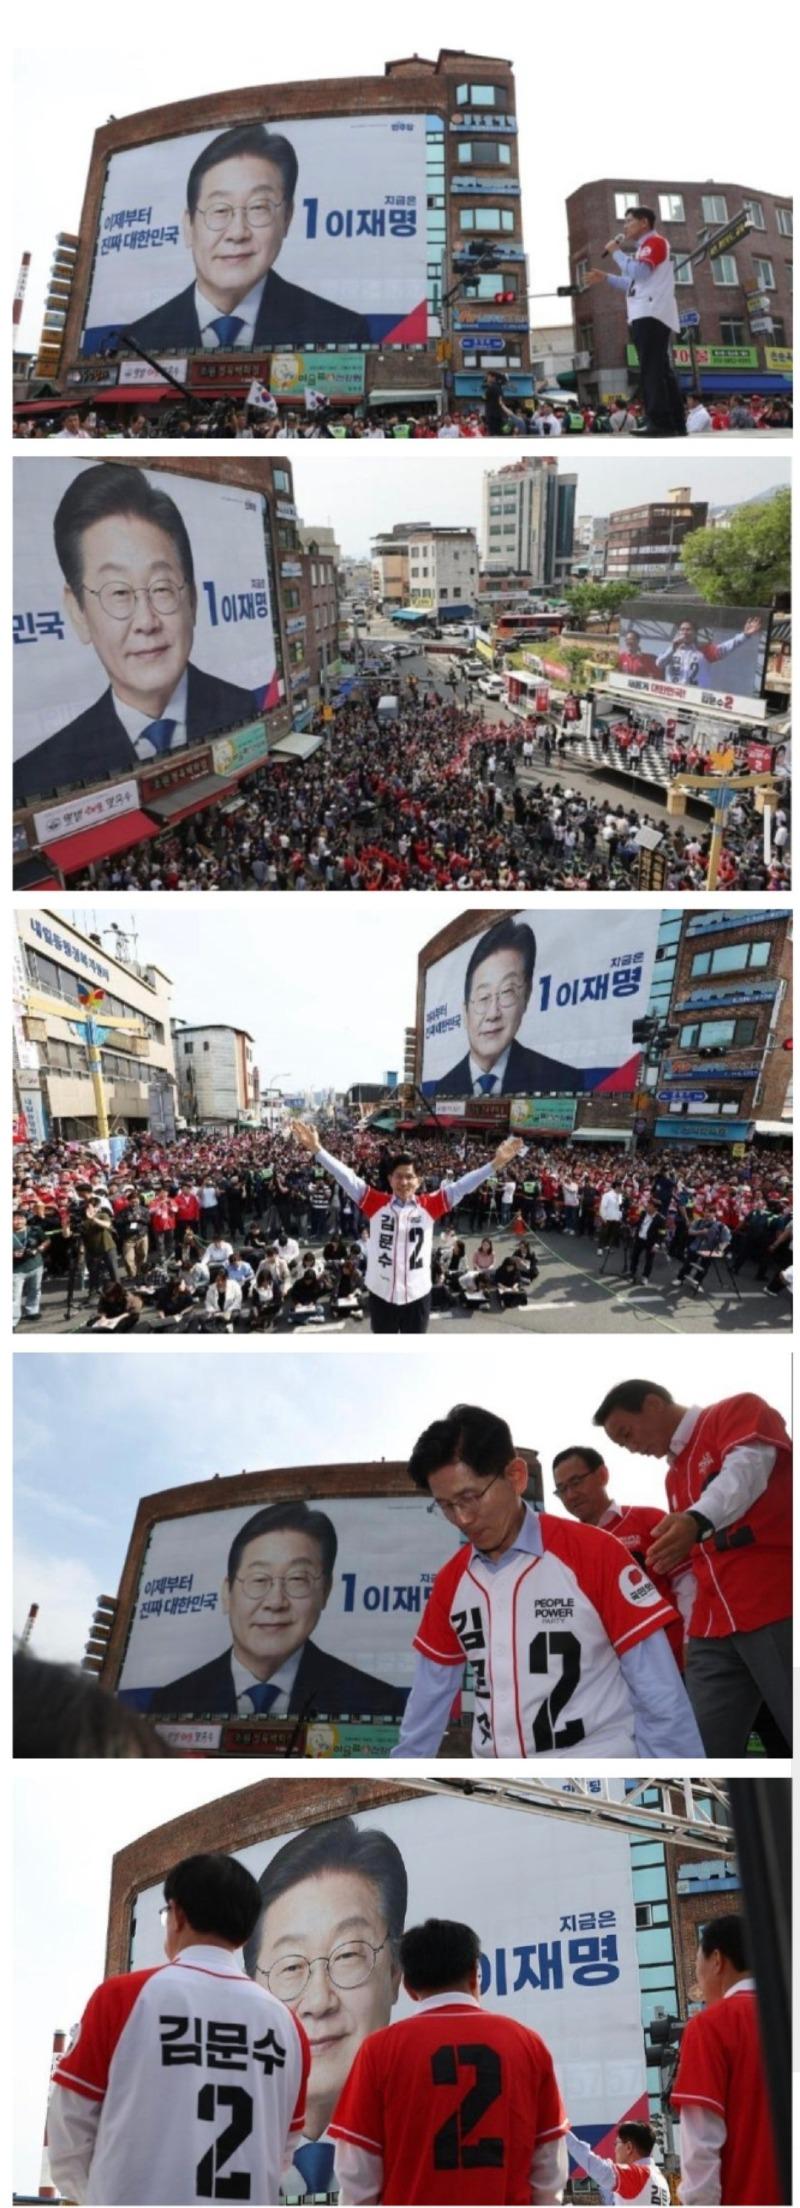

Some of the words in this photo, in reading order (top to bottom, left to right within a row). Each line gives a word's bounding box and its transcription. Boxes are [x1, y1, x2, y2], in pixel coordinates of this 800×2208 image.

[384, 195, 416, 206] 지금은
[104, 206, 152, 232] 이제부터
[303, 198, 318, 239] 1
[326, 209, 417, 237] 이재명
[101, 233, 121, 255] 진짜
[123, 225, 179, 250] 대한민국
[203, 581, 218, 626] 1
[222, 592, 268, 622] 이재명
[13, 611, 64, 644] 민국
[724, 696, 735, 710] 2
[610, 952, 644, 968] 지금은
[539, 974, 551, 1012] 1
[556, 966, 642, 1007] 이재명
[378, 1214, 396, 1268] 김문수
[409, 1227, 424, 1270] 2
[144, 1573, 194, 1597] 이제부터
[342, 1573, 356, 1613] 1
[140, 1600, 163, 1619] 진짜
[164, 1592, 218, 1615] 대한민국
[534, 1598, 575, 1608] PEOPLE
[534, 1608, 574, 1618] POWER
[529, 1631, 586, 1753] 2
[559, 1909, 617, 1933] 지금은
[159, 2015, 287, 2075] 김문수
[431, 2044, 504, 2170] 2
[196, 2083, 254, 2200] 2
